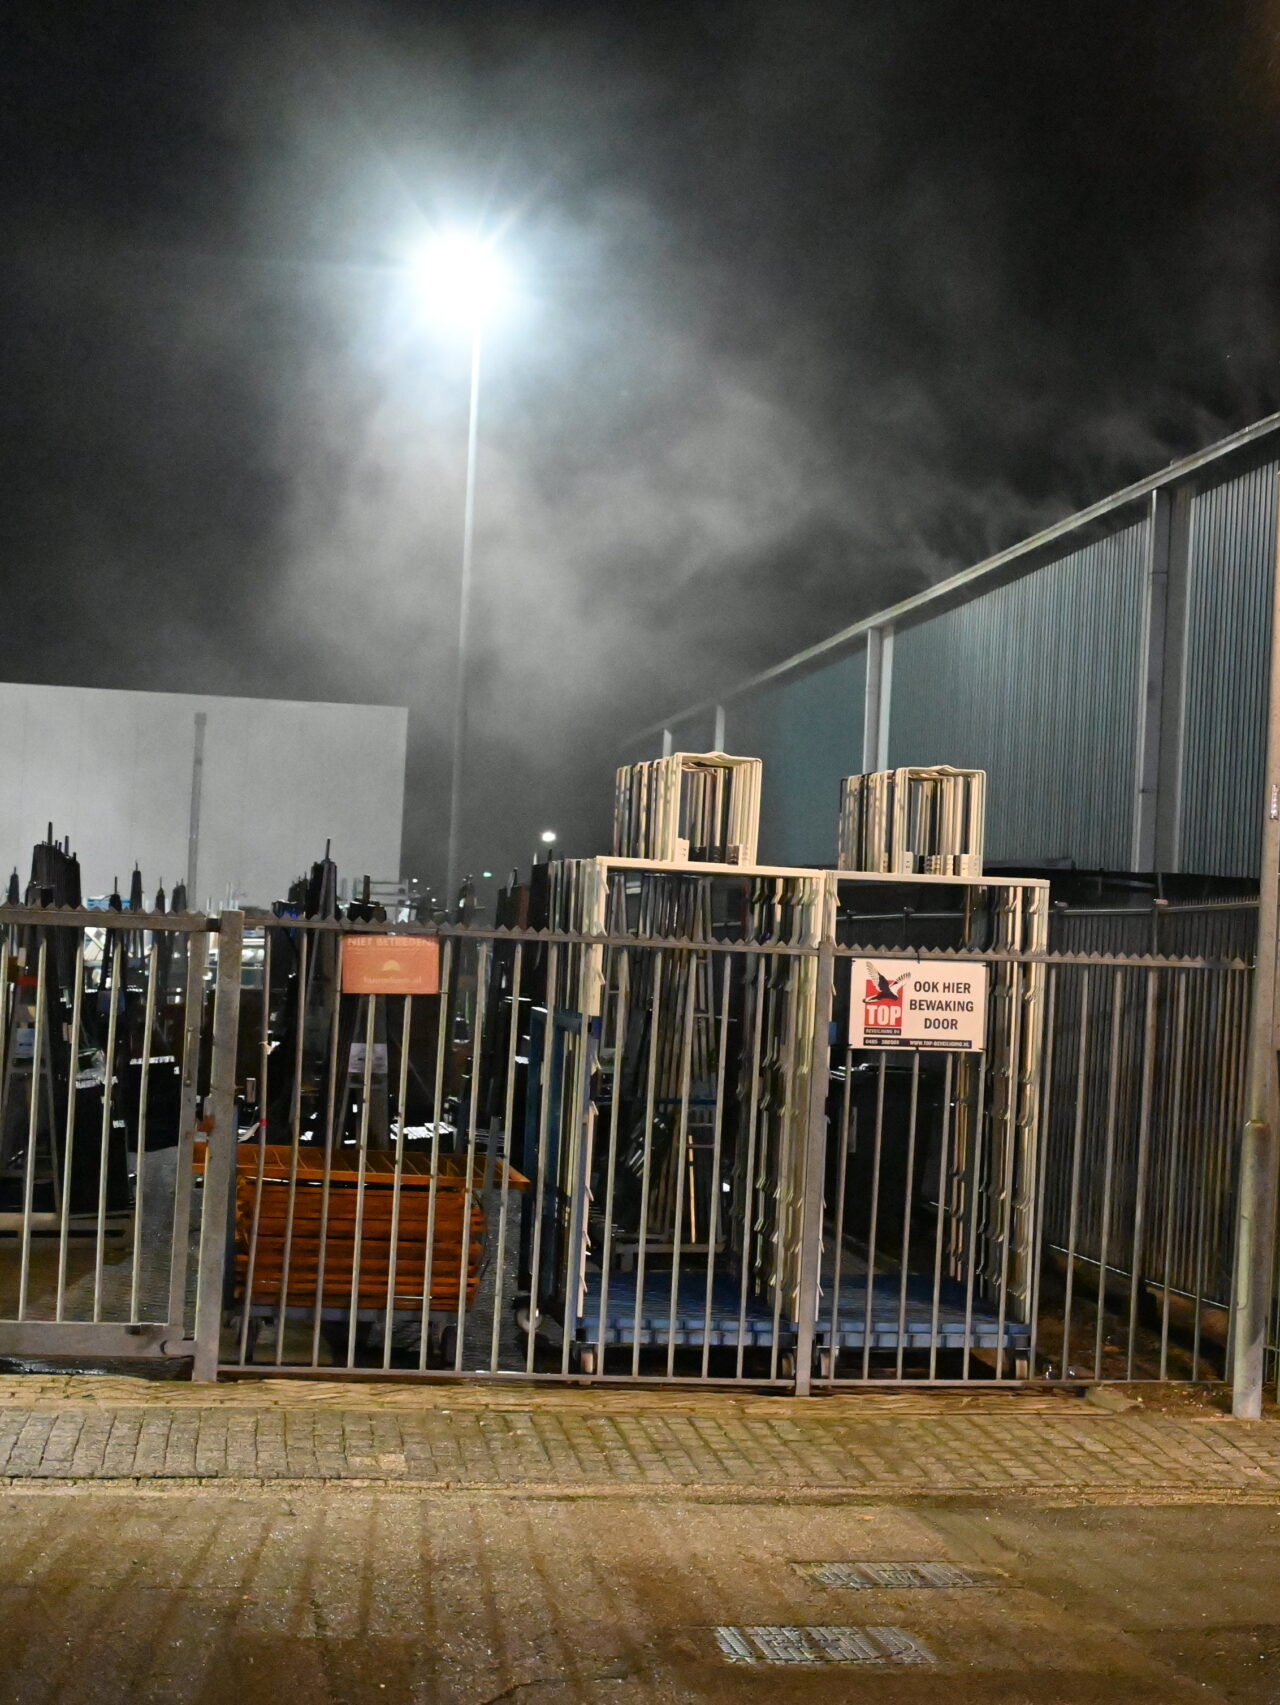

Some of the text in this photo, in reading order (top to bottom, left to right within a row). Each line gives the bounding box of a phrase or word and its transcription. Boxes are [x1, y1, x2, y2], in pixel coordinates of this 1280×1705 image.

[347, 937, 373, 946] NIET
[914, 981, 971, 994] OOK HIER
[909, 999, 974, 1012] BEWAKING
[866, 1005, 901, 1026] TOP
[924, 1018, 958, 1030] DOOR
